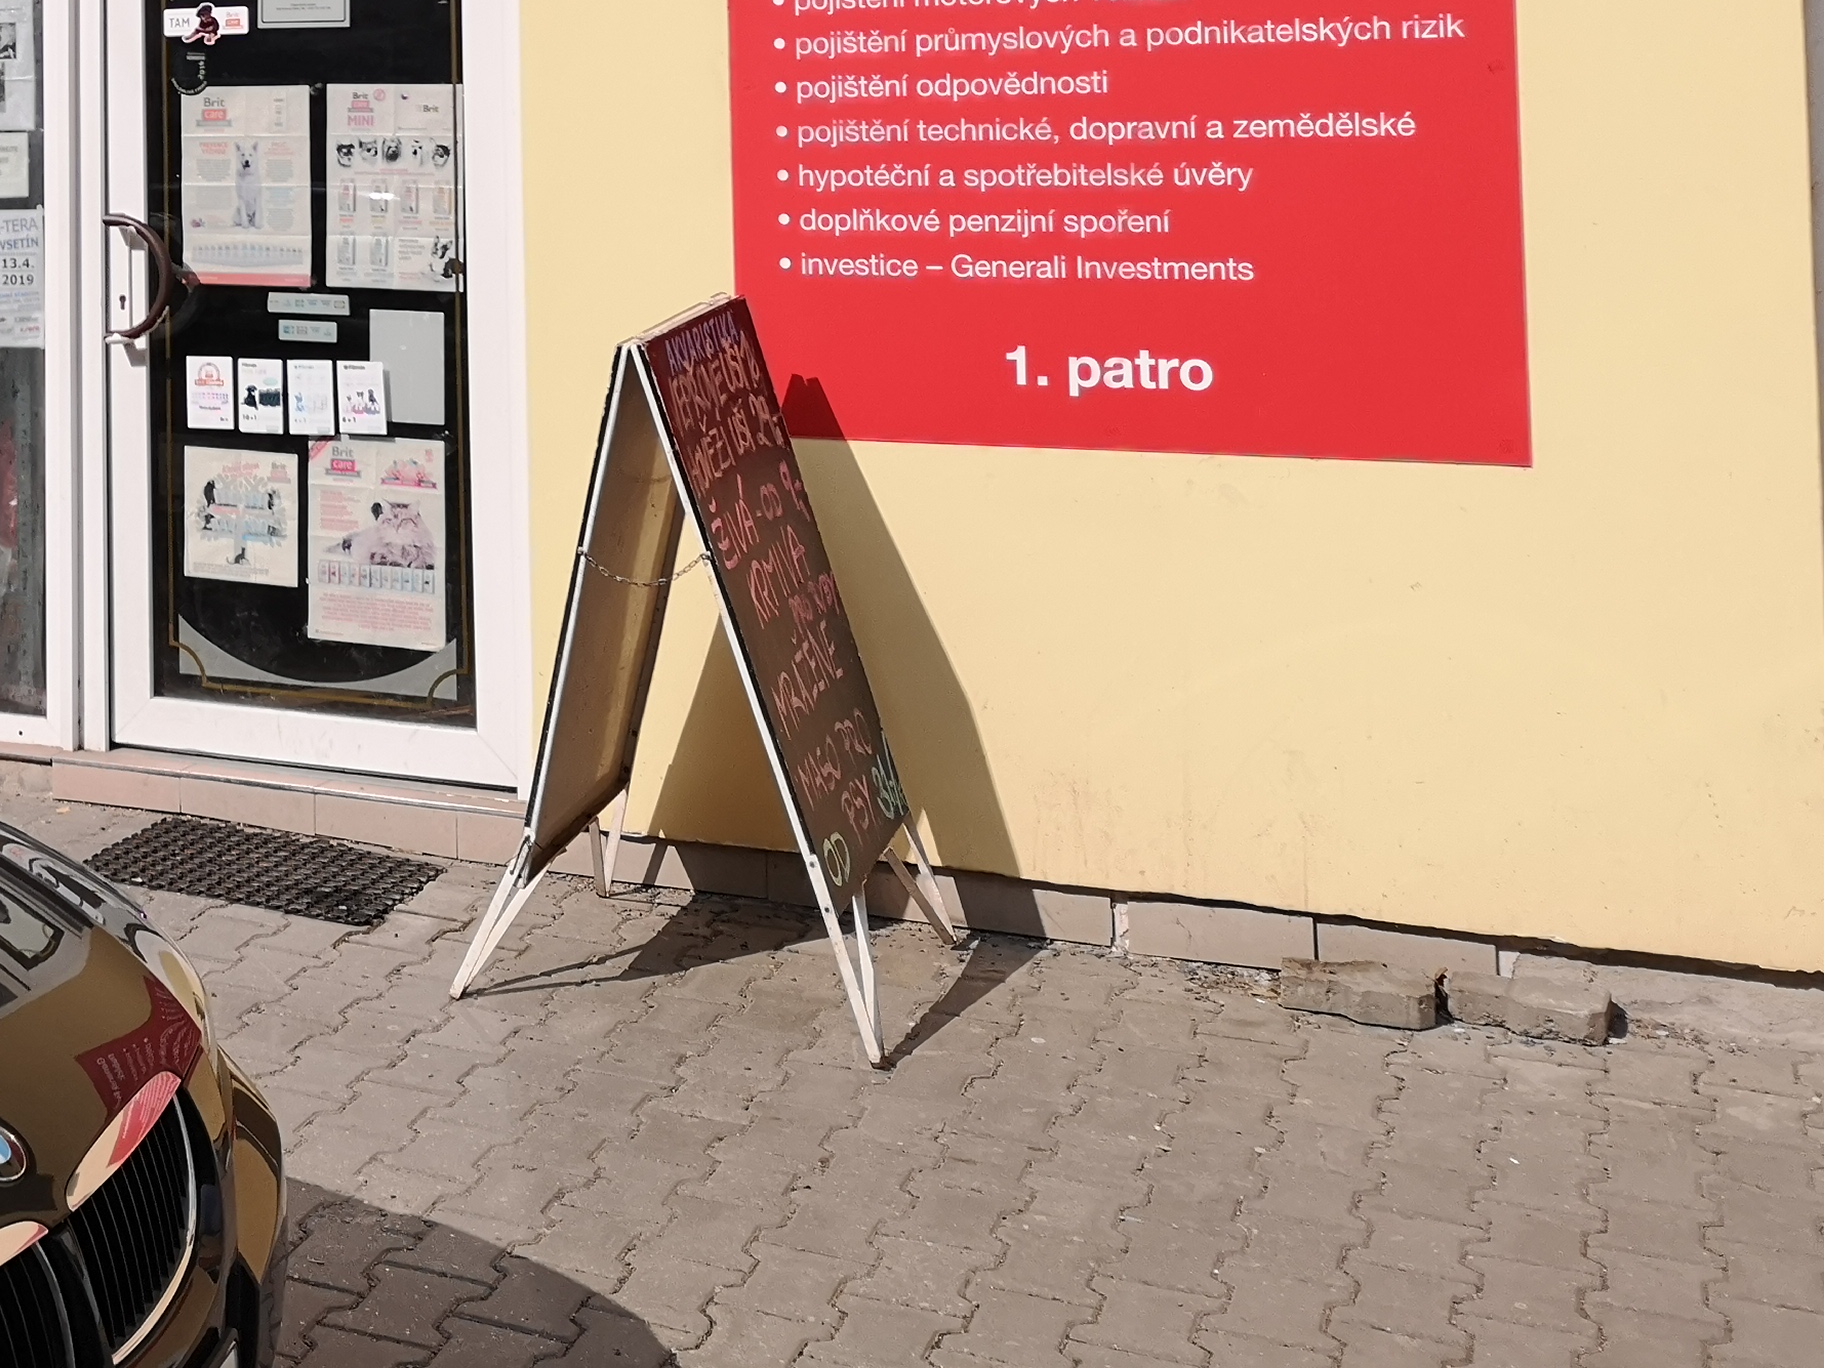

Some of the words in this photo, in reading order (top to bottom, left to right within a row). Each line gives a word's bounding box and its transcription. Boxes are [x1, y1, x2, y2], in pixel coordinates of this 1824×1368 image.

[169, 17, 190, 28] TAM
[794, 27, 908, 61] pojištění
[915, 20, 1110, 56] průmyslových
[1118, 29, 1138, 48] a
[1145, 13, 1392, 52] podnikatelských
[1399, 13, 1465, 42] rizik
[203, 97, 225, 107] Brit
[352, 91, 368, 99] Brit
[795, 72, 909, 107] pojištění
[915, 68, 1109, 102] odpovědnosti
[204, 110, 225, 120] care
[347, 115, 375, 126] MINI
[423, 104, 439, 113] Brit
[796, 117, 910, 151] pojištění
[916, 115, 1061, 147] technické,
[1068, 113, 1197, 146] dopravní
[1205, 121, 1225, 140] a
[1231, 112, 1416, 141] zemědělské
[797, 161, 930, 196] hypotéční
[937, 169, 957, 189] a
[963, 159, 1165, 193] spotřebitelské
[1172, 160, 1254, 193] úvěry
[798, 207, 941, 237] doplňkové
[947, 208, 1055, 240] penzijní
[1061, 208, 1171, 239] spoření
[1, 257, 35, 270] 13.4.
[2, 273, 34, 286] 2019
[799, 252, 919, 280] investice
[950, 251, 1068, 281] Generali
[1075, 253, 1255, 282] Investments
[665, 310, 740, 376] AKVARISTIKA
[1004, 345, 1049, 387] 1.
[1067, 347, 1214, 396] patro
[331, 445, 354, 458] Brit
[332, 459, 354, 471] care
[710, 473, 760, 570] ŽIVÁ
[746, 525, 811, 629] KRMIVA
[795, 735, 842, 812] MASO
[833, 706, 873, 768] PRO
[841, 774, 878, 847] PSY
[823, 831, 851, 887] OD
